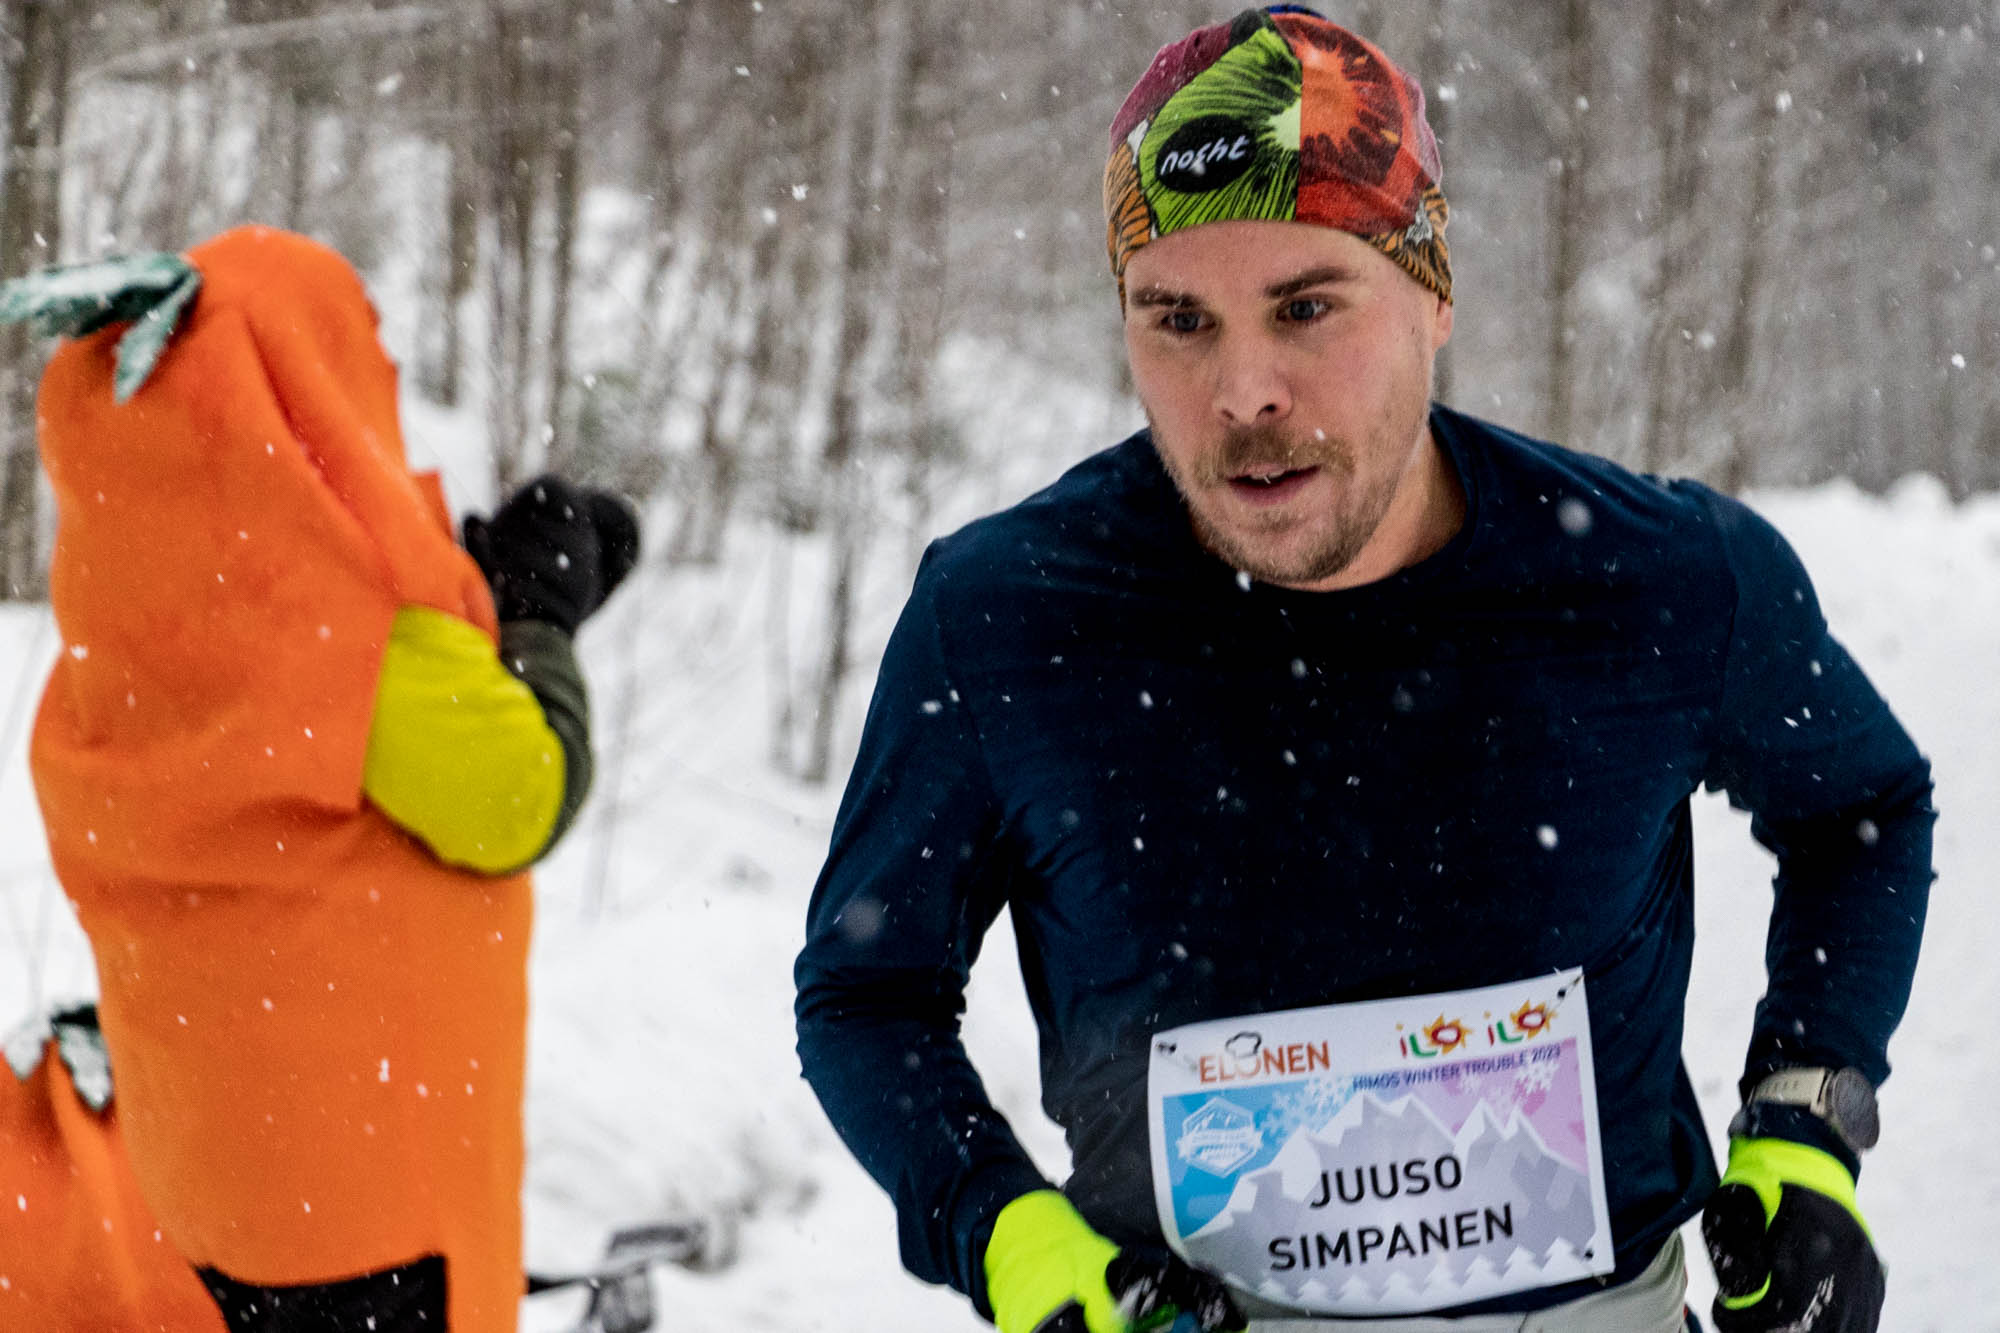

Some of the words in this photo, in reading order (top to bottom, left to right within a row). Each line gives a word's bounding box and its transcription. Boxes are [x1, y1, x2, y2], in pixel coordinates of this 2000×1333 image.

[1353, 1070, 1400, 1091] HIMOS
[1403, 1065, 1461, 1085] WINTER
[1464, 1054, 1527, 1075] TROUBLE
[1530, 1043, 1561, 1063] 2023
[1310, 1154, 1463, 1209] JUUSO
[1268, 1202, 1514, 1271] SIMPANEN
